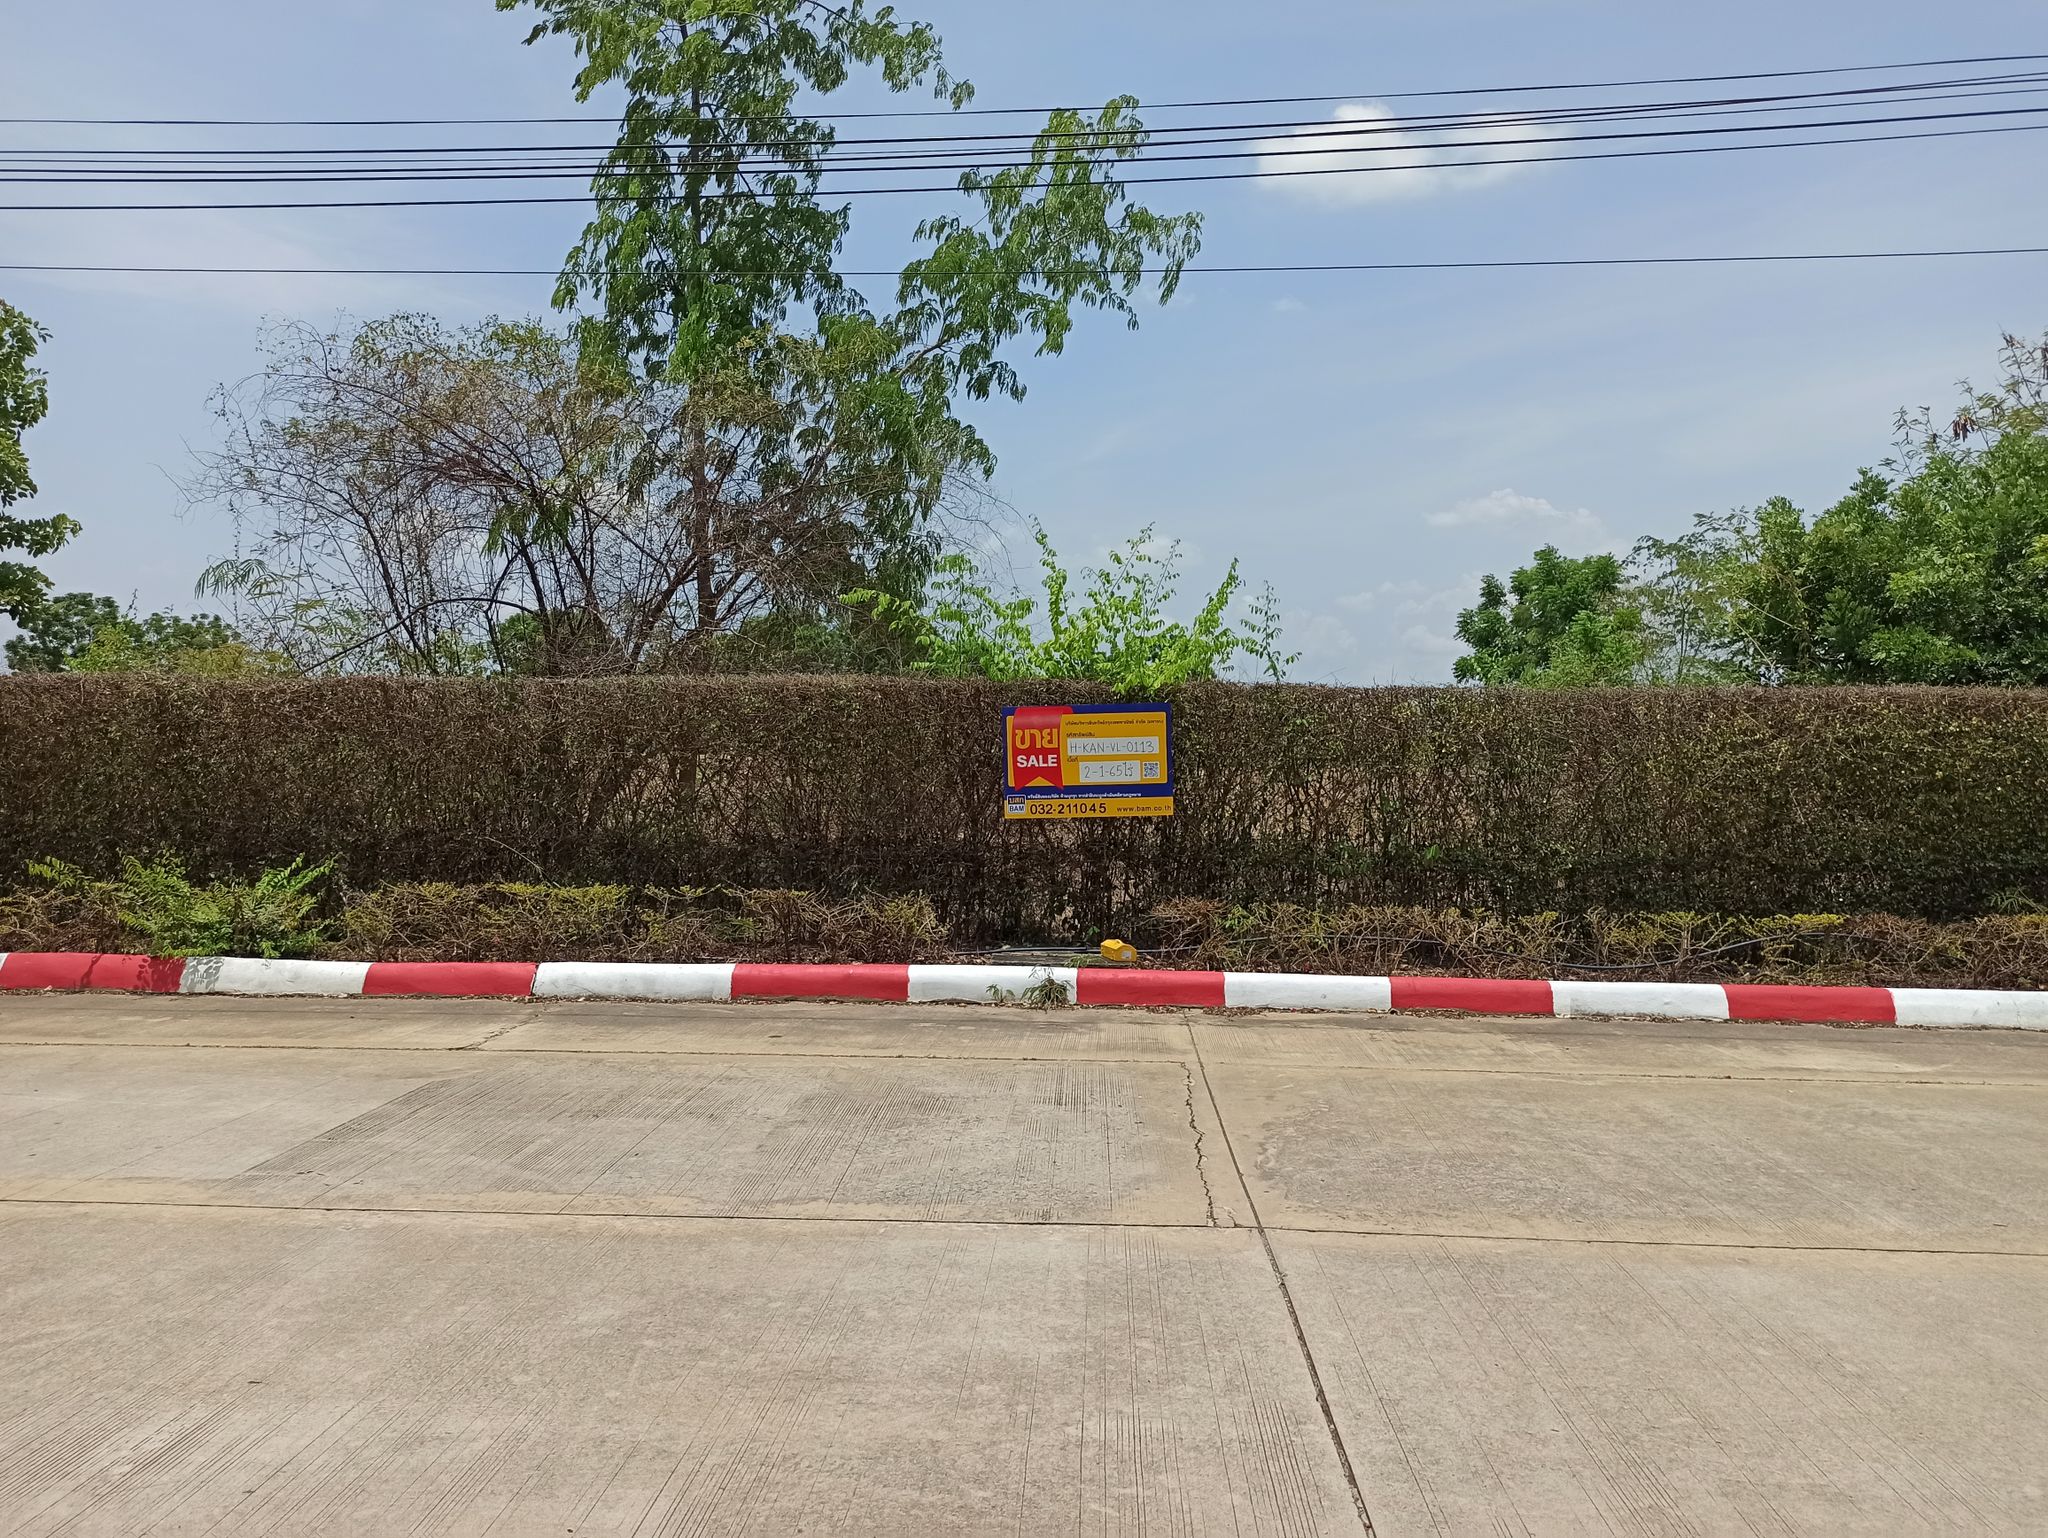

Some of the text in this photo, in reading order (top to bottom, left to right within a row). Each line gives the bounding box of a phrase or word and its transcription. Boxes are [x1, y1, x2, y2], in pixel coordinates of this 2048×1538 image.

[1015, 728, 1058, 749] ขาย
[1070, 740, 1155, 753] H-KAN-VL-0113
[1016, 754, 1058, 767] SALE
[1030, 803, 1107, 815] 032-211045
